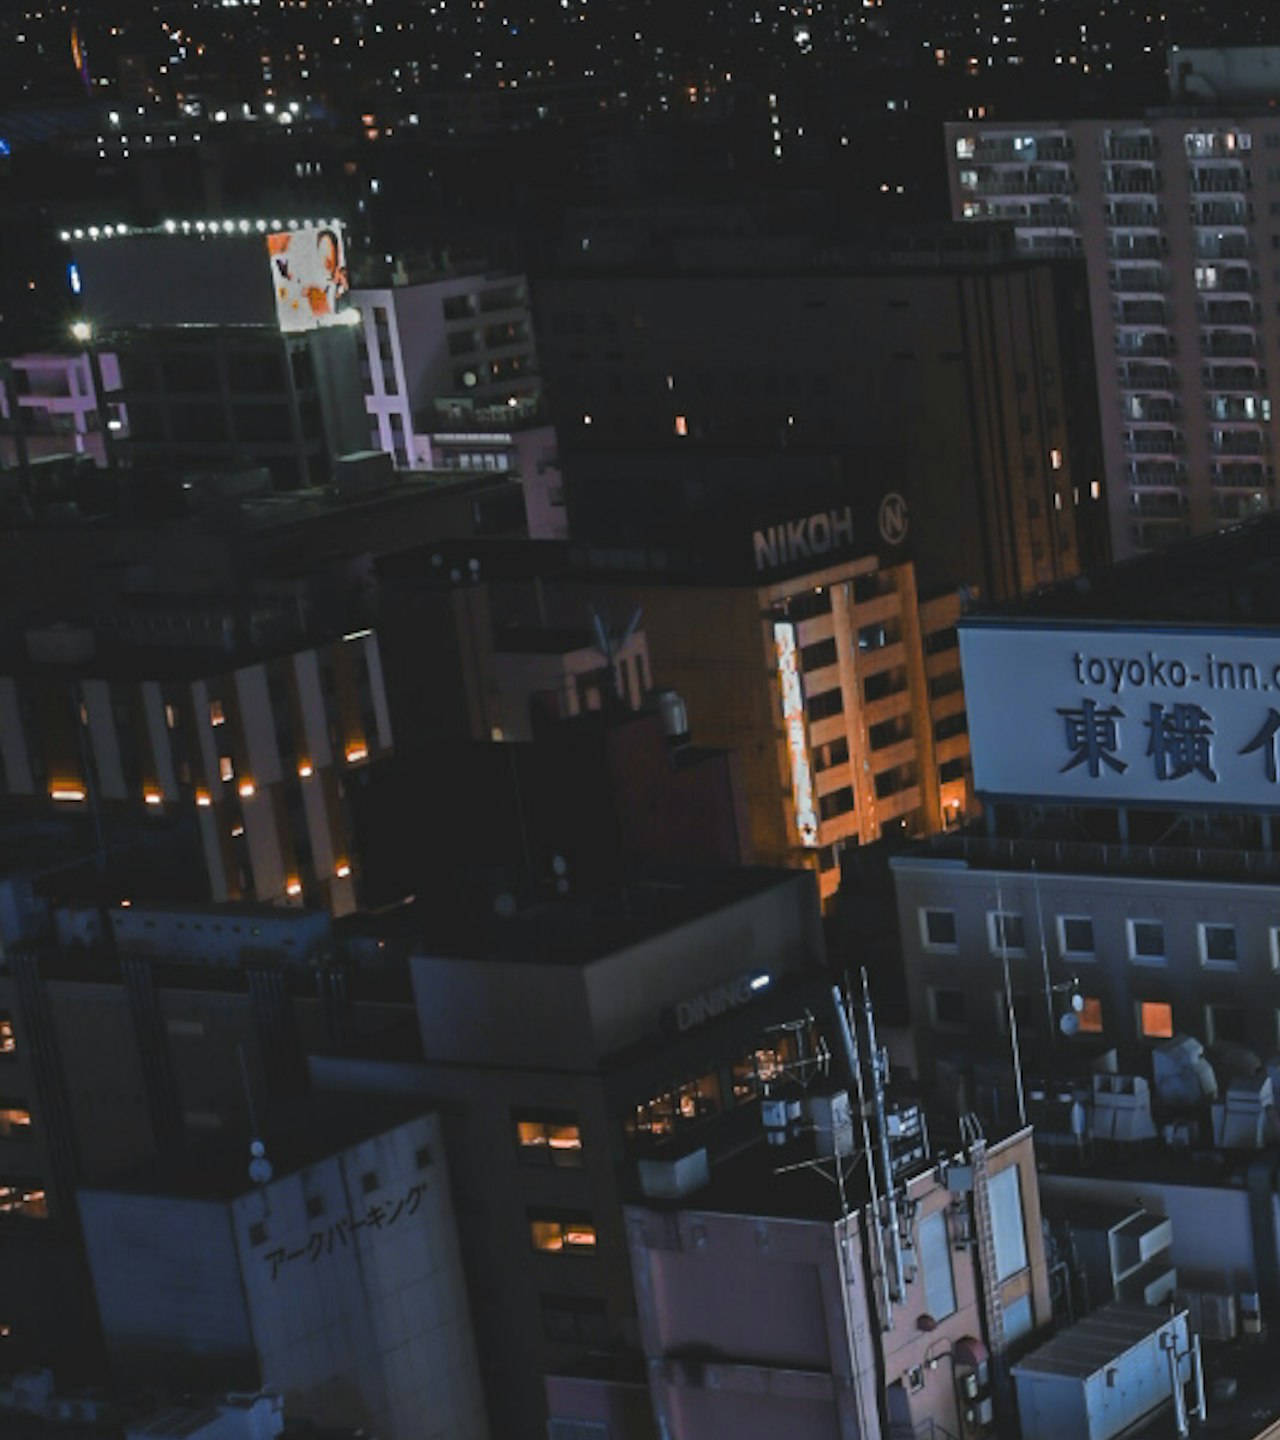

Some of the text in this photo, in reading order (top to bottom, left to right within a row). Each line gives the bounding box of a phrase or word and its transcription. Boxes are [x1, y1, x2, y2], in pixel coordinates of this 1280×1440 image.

[753, 505, 855, 572] NIKOH
[264, 1184, 428, 1281] アークパーキング
